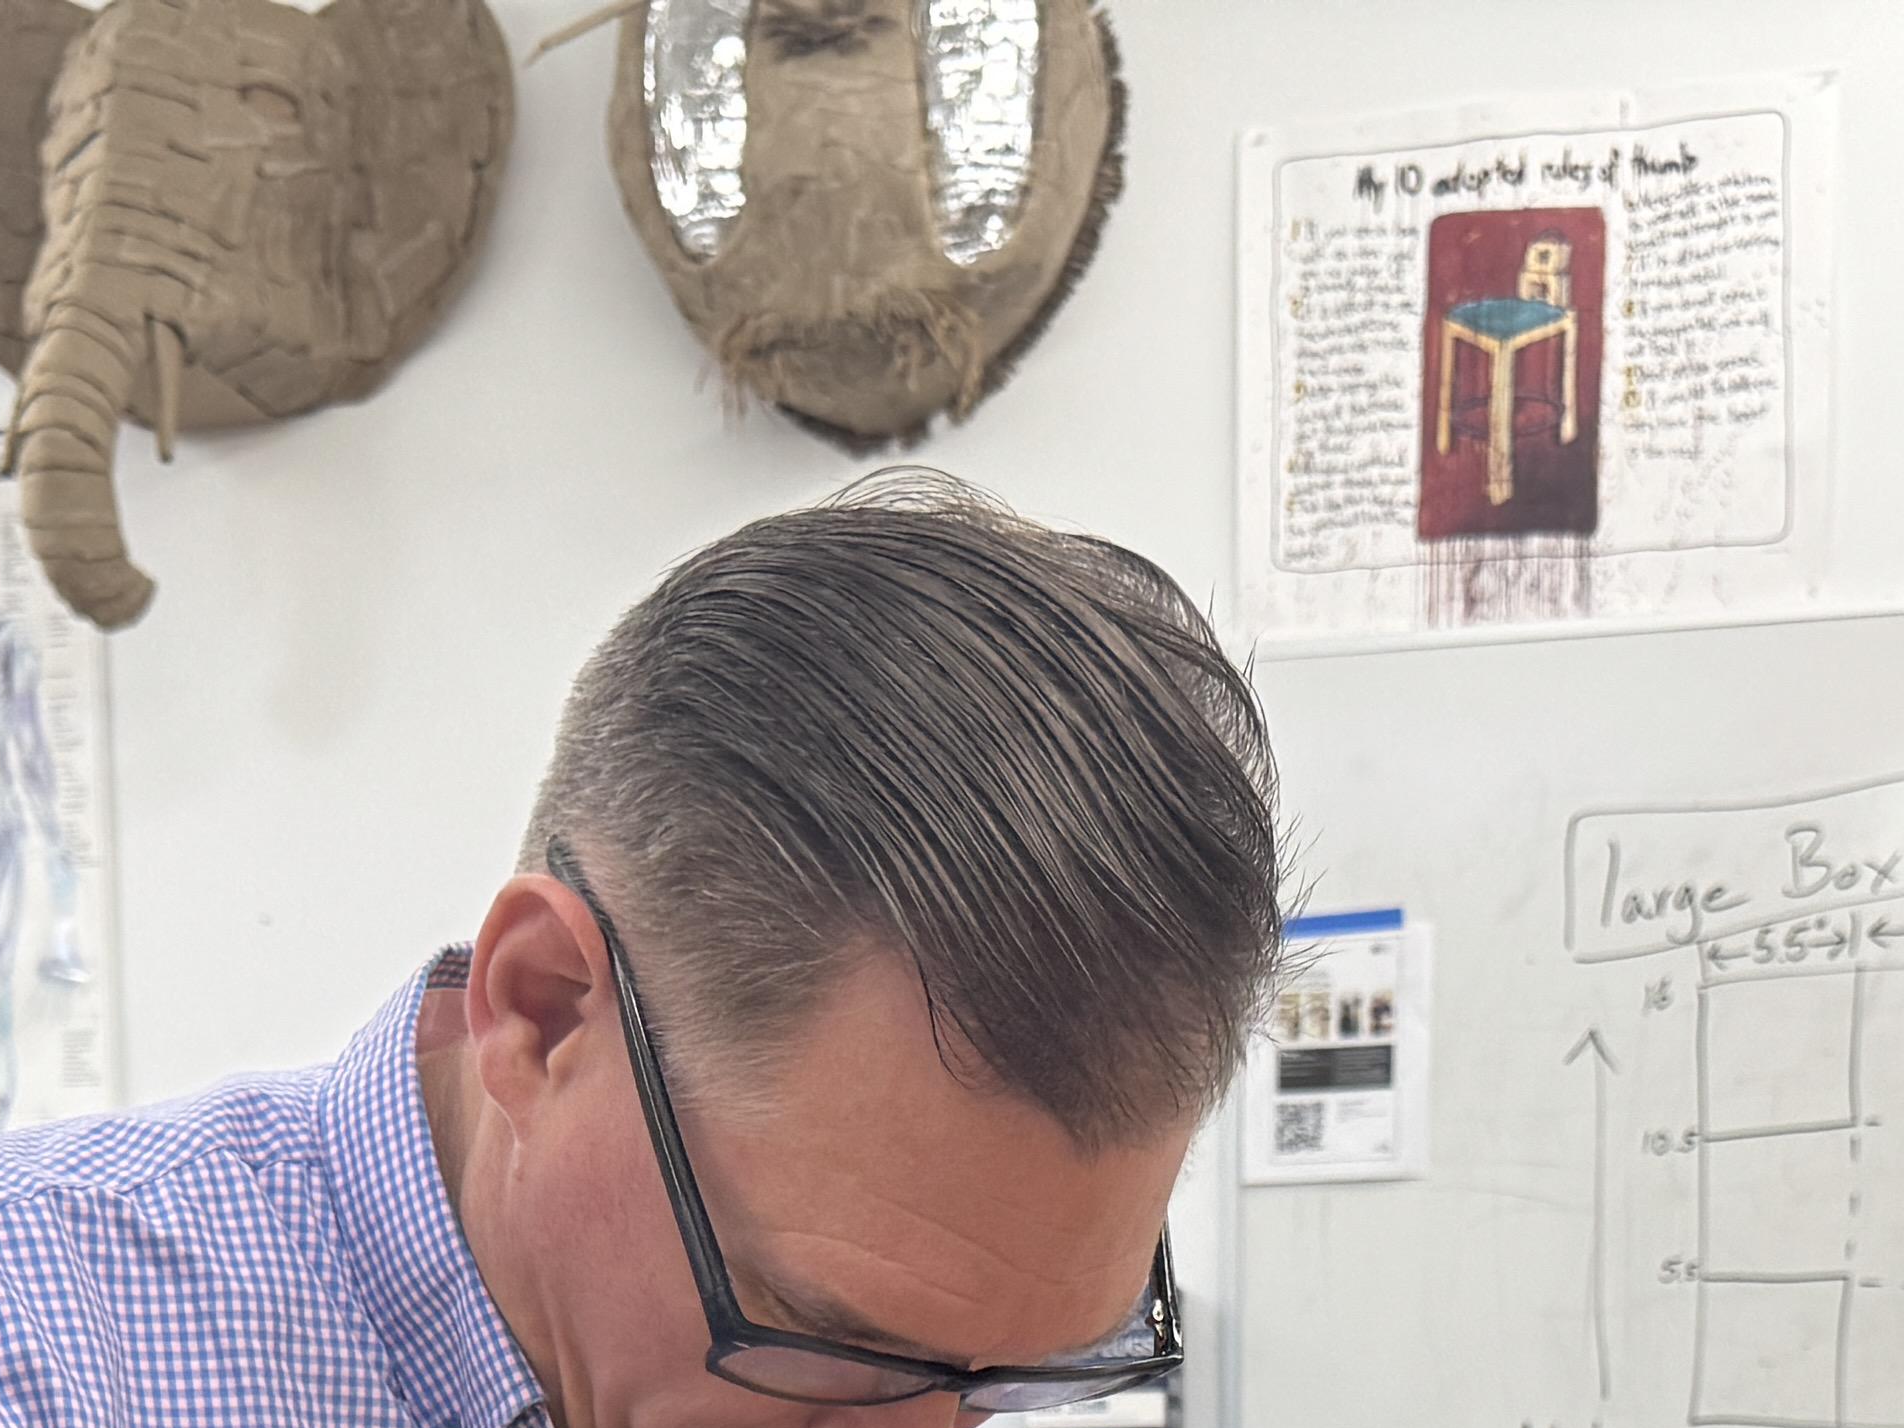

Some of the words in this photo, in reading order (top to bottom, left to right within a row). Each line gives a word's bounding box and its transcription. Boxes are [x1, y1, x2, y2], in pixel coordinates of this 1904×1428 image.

[1396, 163, 1424, 198] 10
[1430, 150, 1526, 198] adopted
[1597, 147, 1620, 189] of
[1630, 141, 1698, 176] thumb
[1781, 823, 1904, 899] Box
